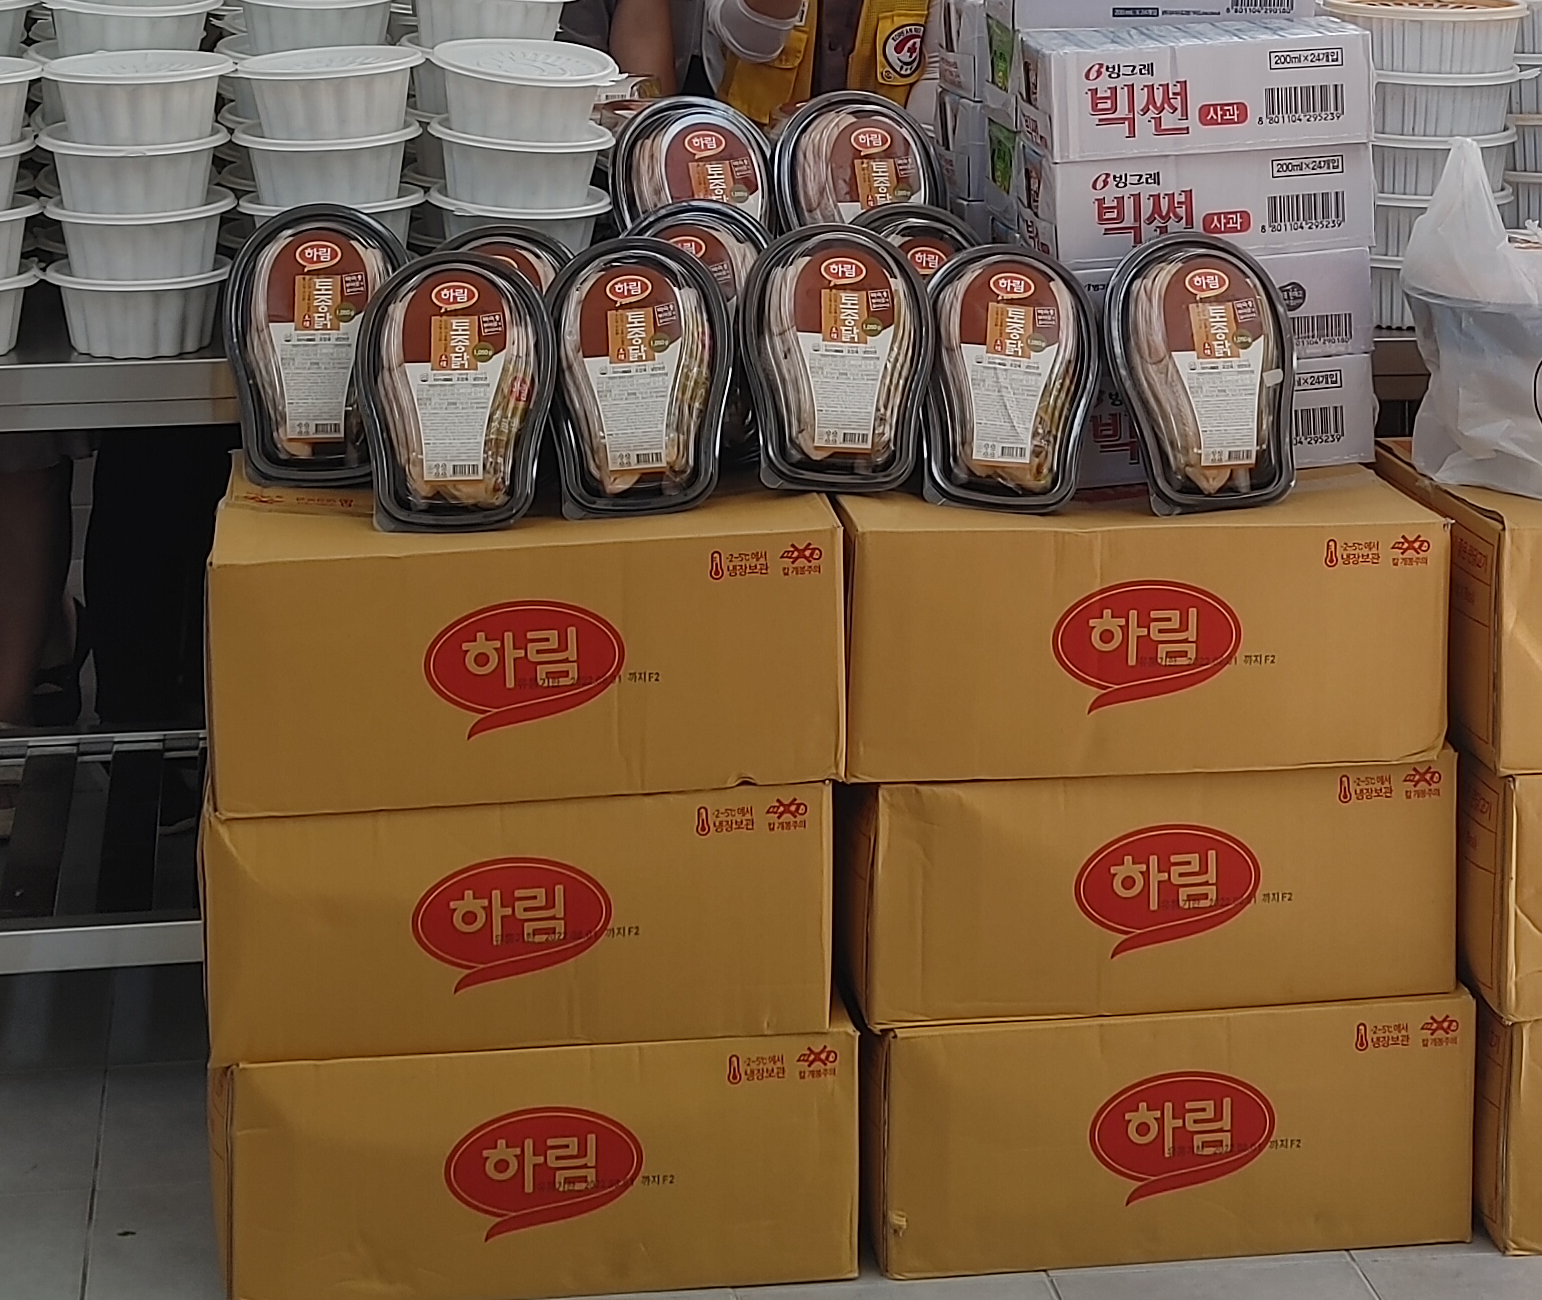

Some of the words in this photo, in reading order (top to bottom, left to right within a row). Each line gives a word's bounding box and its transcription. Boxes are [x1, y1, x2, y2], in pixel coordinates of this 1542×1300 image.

[1105, 62, 1155, 80] 빙그레
[1085, 78, 1191, 139] 빅썬
[1206, 105, 1240, 123] 사과
[692, 137, 717, 150] 하림
[858, 133, 882, 147] 하림
[1112, 170, 1161, 189] 빙그레
[1210, 213, 1243, 231] 사과
[304, 247, 332, 262] 하림
[915, 252, 939, 269] 하림
[829, 263, 856, 278] 하림
[614, 281, 641, 296] 하림
[998, 278, 1025, 293] 하림
[1193, 275, 1220, 290] 하림
[313, 277, 333, 330] 토종닭
[440, 288, 468, 303] 하림
[839, 292, 859, 343] 토종닭
[625, 310, 646, 362] 토종닭
[1005, 307, 1026, 357] 토종닭
[1208, 305, 1231, 358] 토종닭
[450, 319, 470, 369] 토종닭
[1341, 552, 1381, 565] 냉장보관
[727, 564, 769, 577] 냉장보관
[1088, 608, 1198, 666] 하림
[462, 626, 579, 690] 하림
[1354, 787, 1393, 800] 냉장보관
[713, 819, 754, 832] 냉장보관
[1109, 849, 1219, 910] 하림
[449, 885, 565, 945] 하림
[1371, 1035, 1409, 1048] 냉장보관
[744, 1067, 785, 1080] 냉장보관
[1124, 1097, 1233, 1157] 하림
[482, 1133, 598, 1193] 하림
